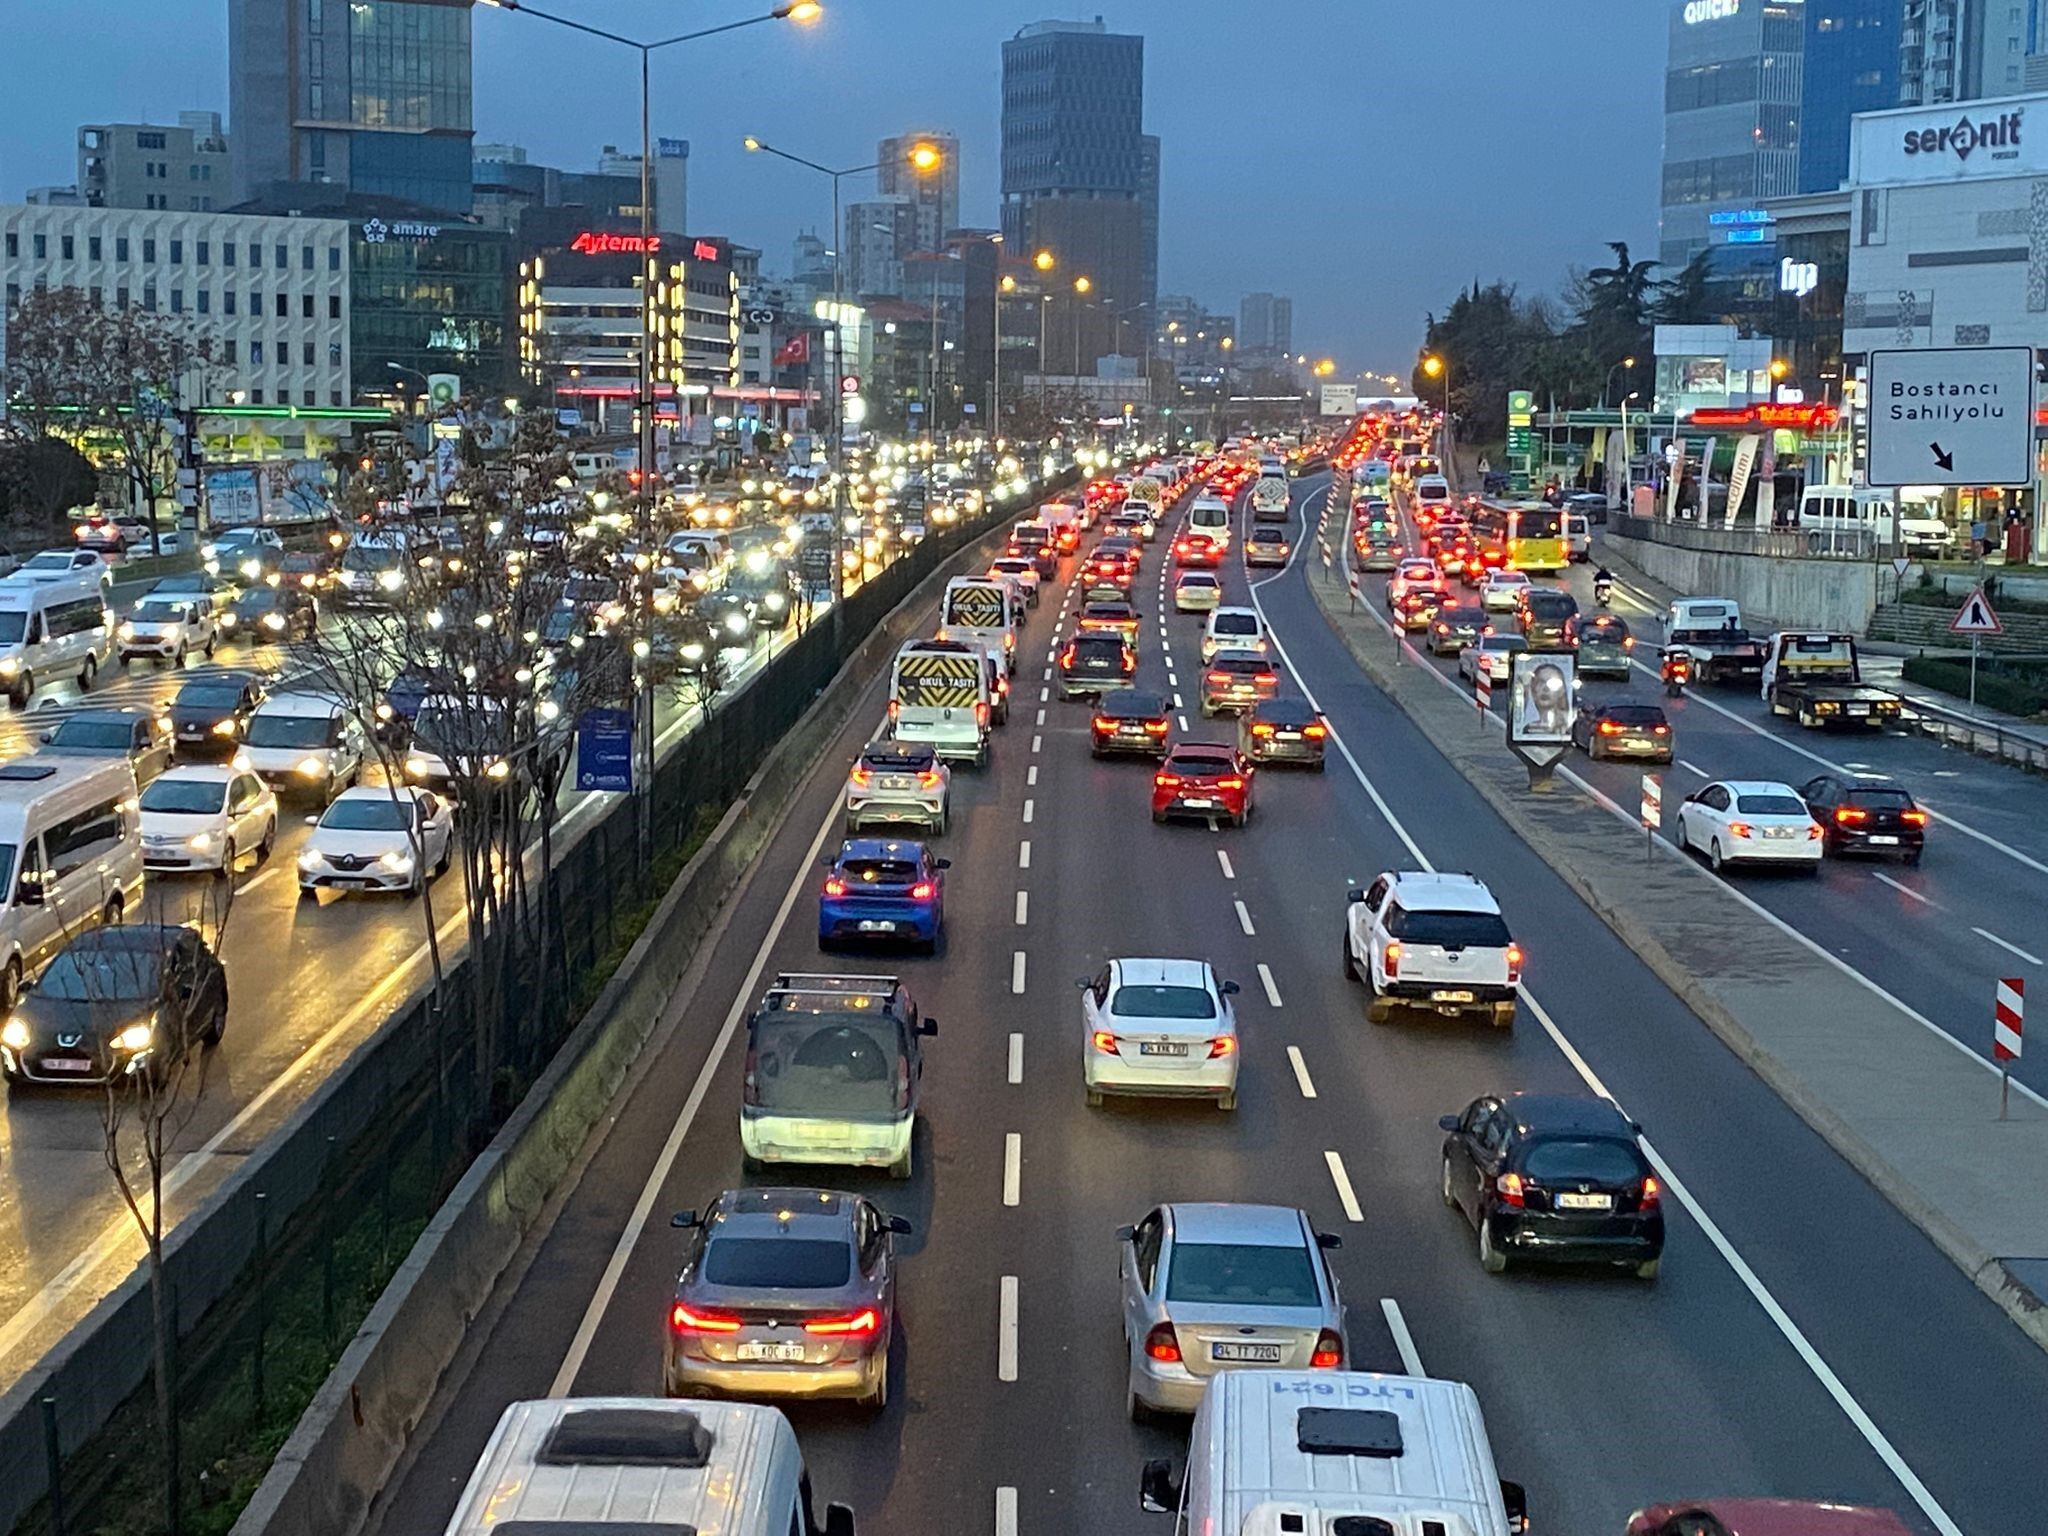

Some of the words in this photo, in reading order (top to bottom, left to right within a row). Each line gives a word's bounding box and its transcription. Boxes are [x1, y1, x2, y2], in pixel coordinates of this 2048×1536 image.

[392, 223, 437, 236] amare
[1891, 382, 1998, 397] Bostancı
[1890, 403, 2004, 422] Sahilyolu
[952, 604, 973, 612] OKUL
[919, 677, 944, 686] OKUL
[948, 677, 976, 688] TAŞITI
[785, 1347, 802, 1358] 617
[1218, 1345, 1231, 1356] 34
[1254, 1346, 1278, 1358] 7204
